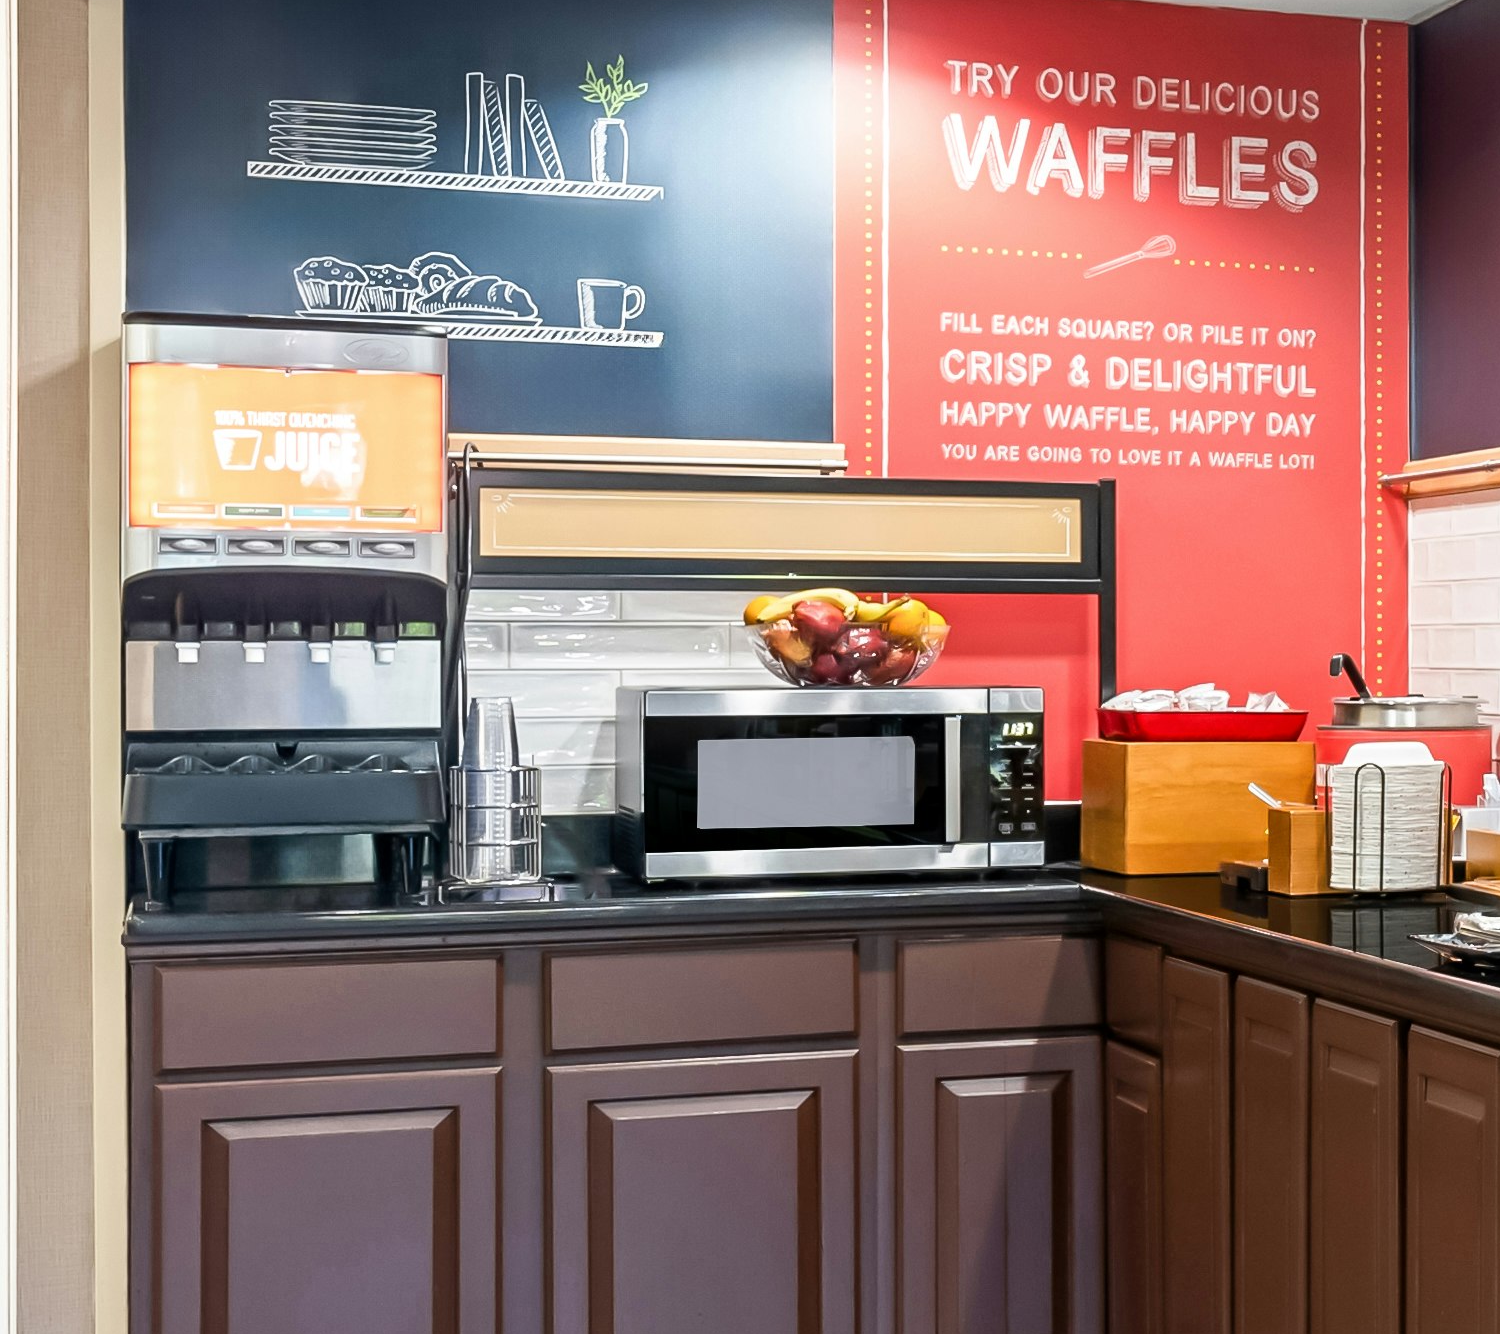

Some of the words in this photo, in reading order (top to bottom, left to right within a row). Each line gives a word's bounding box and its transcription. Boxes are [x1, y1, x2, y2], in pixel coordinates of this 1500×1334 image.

[943, 59, 1019, 99] TRY
[1034, 67, 1117, 108] OUR
[1132, 75, 1320, 123] DELICIOUS
[941, 112, 1320, 214] WAFFLES
[939, 312, 983, 334] FILL
[991, 314, 1049, 337] EACH
[1057, 317, 1155, 341] SQUARE?
[1163, 322, 1193, 343] OR
[1200, 324, 1244, 346] PILE
[1251, 327, 1269, 346] IT
[1277, 328, 1317, 349] ON?
[939, 348, 1052, 387] CRISP
[1067, 354, 1090, 388] &
[1105, 356, 1317, 398] DELIGHTFUL
[214, 410, 246, 426] 100%
[246, 410, 287, 427] THIRST
[939, 400, 1032, 428] HAPPY
[1043, 403, 1160, 436] WAFFLE,
[1169, 408, 1256, 436] HAPPY
[1266, 411, 1317, 438] DAY
[264, 430, 361, 473] JUICE
[941, 443, 977, 461] YOU
[983, 444, 1020, 462] ARE
[1027, 445, 1083, 463] GOING
[1089, 448, 1112, 464] TO
[1118, 448, 1161, 466] LOVE
[1167, 450, 1183, 466] IT
[1189, 451, 1201, 467] A
[1208, 451, 1273, 469] WAFFLE
[1279, 453, 1315, 470] LOT!
